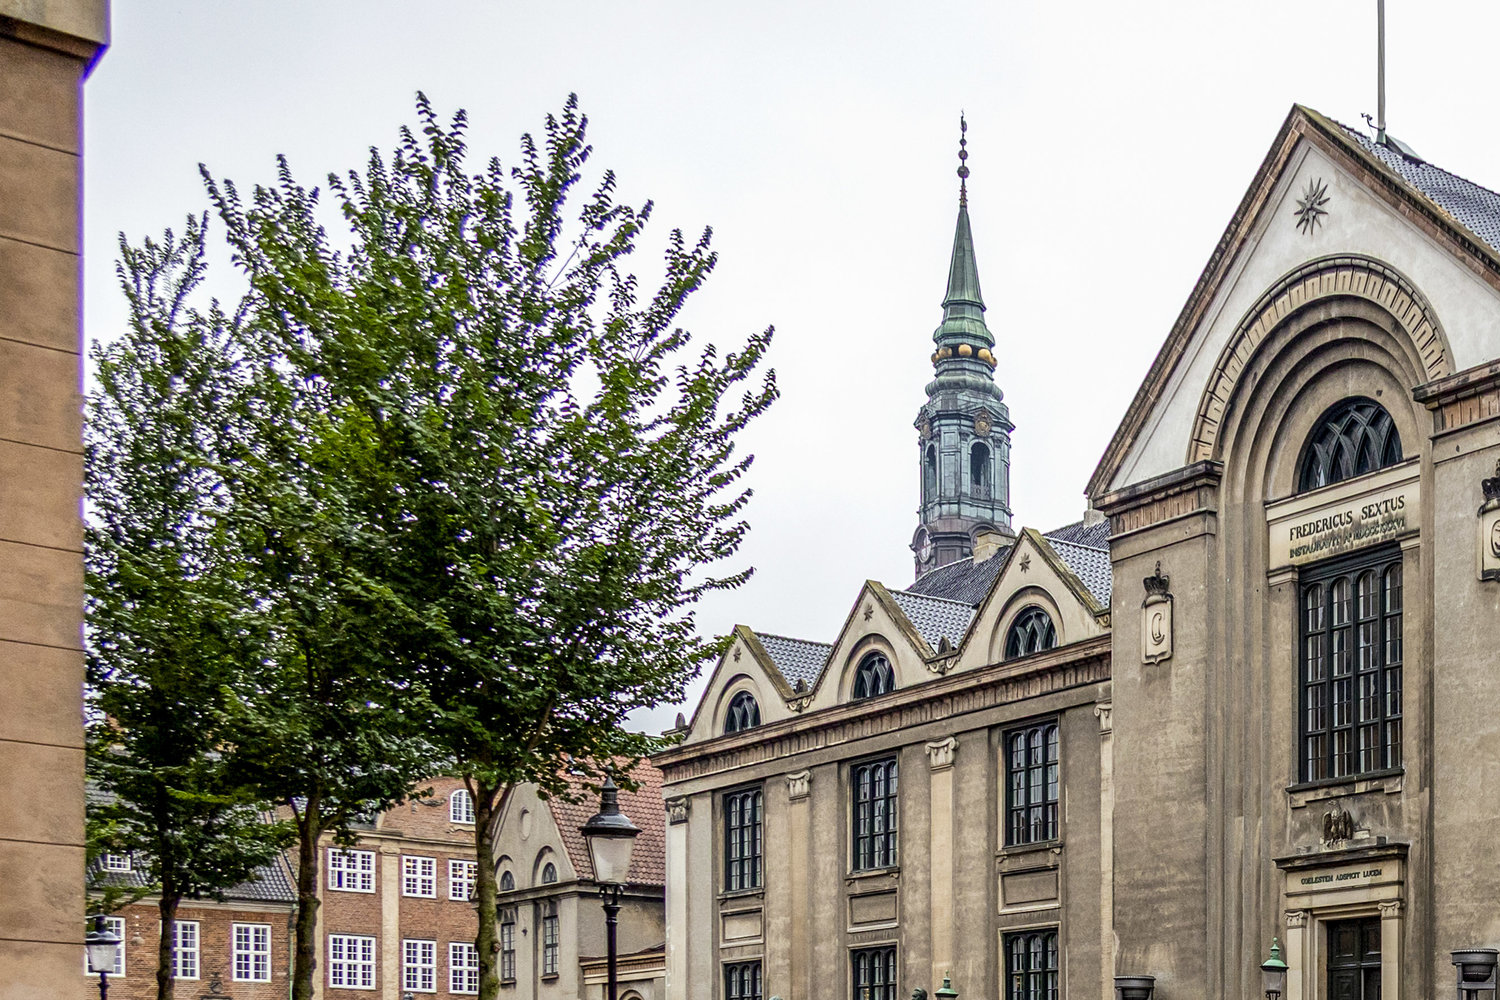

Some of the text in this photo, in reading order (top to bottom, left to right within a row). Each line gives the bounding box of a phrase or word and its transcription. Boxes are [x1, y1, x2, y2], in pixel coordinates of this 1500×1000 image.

[1289, 494, 1405, 541] FREDERICUS SEXTUS
[1363, 869, 1382, 878] LUCEM
